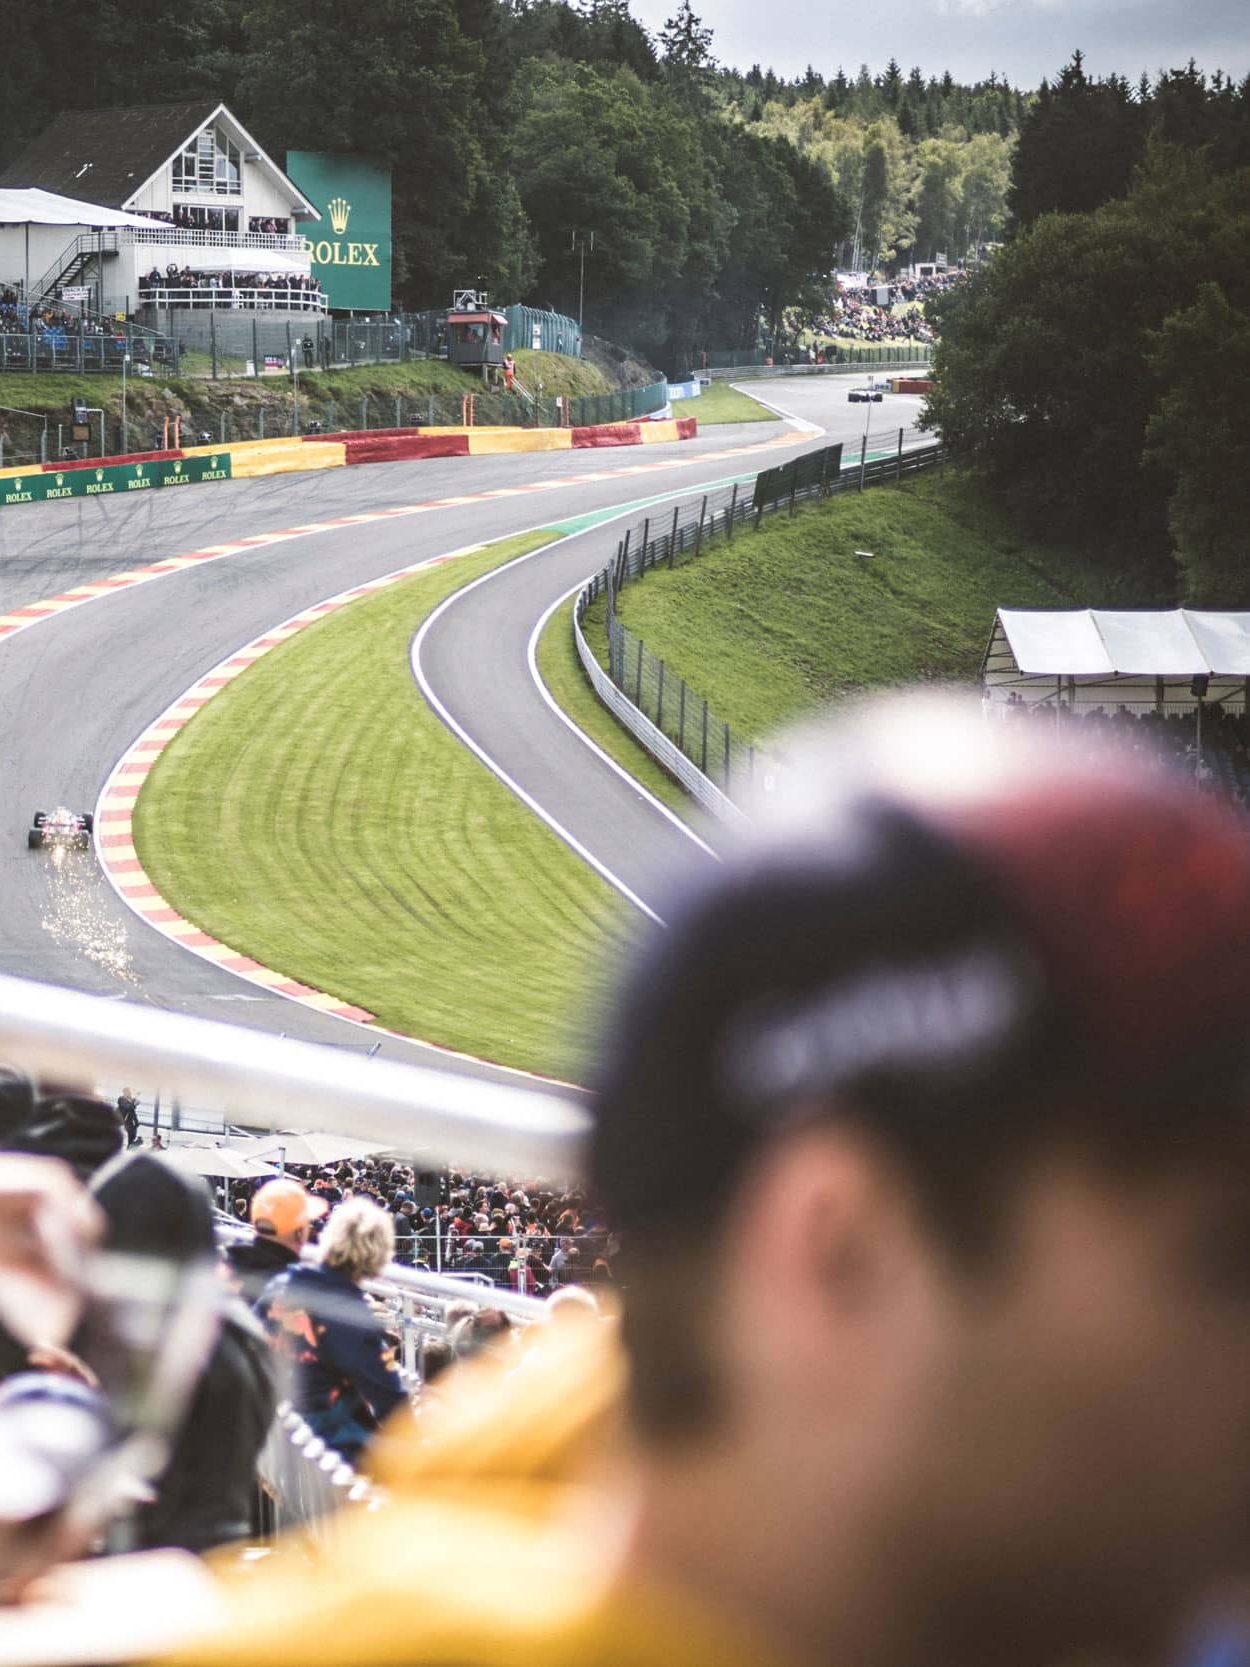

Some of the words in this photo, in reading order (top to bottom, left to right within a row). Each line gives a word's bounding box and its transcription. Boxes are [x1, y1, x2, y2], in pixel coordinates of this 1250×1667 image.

[164, 474, 190, 485] ROLEX
[202, 470, 227, 480] ROLEX
[86, 482, 114, 494] ROLEX
[128, 478, 150, 489] ROLEX
[6, 492, 32, 503] ROLEX
[47, 487, 72, 498] ROLEX
